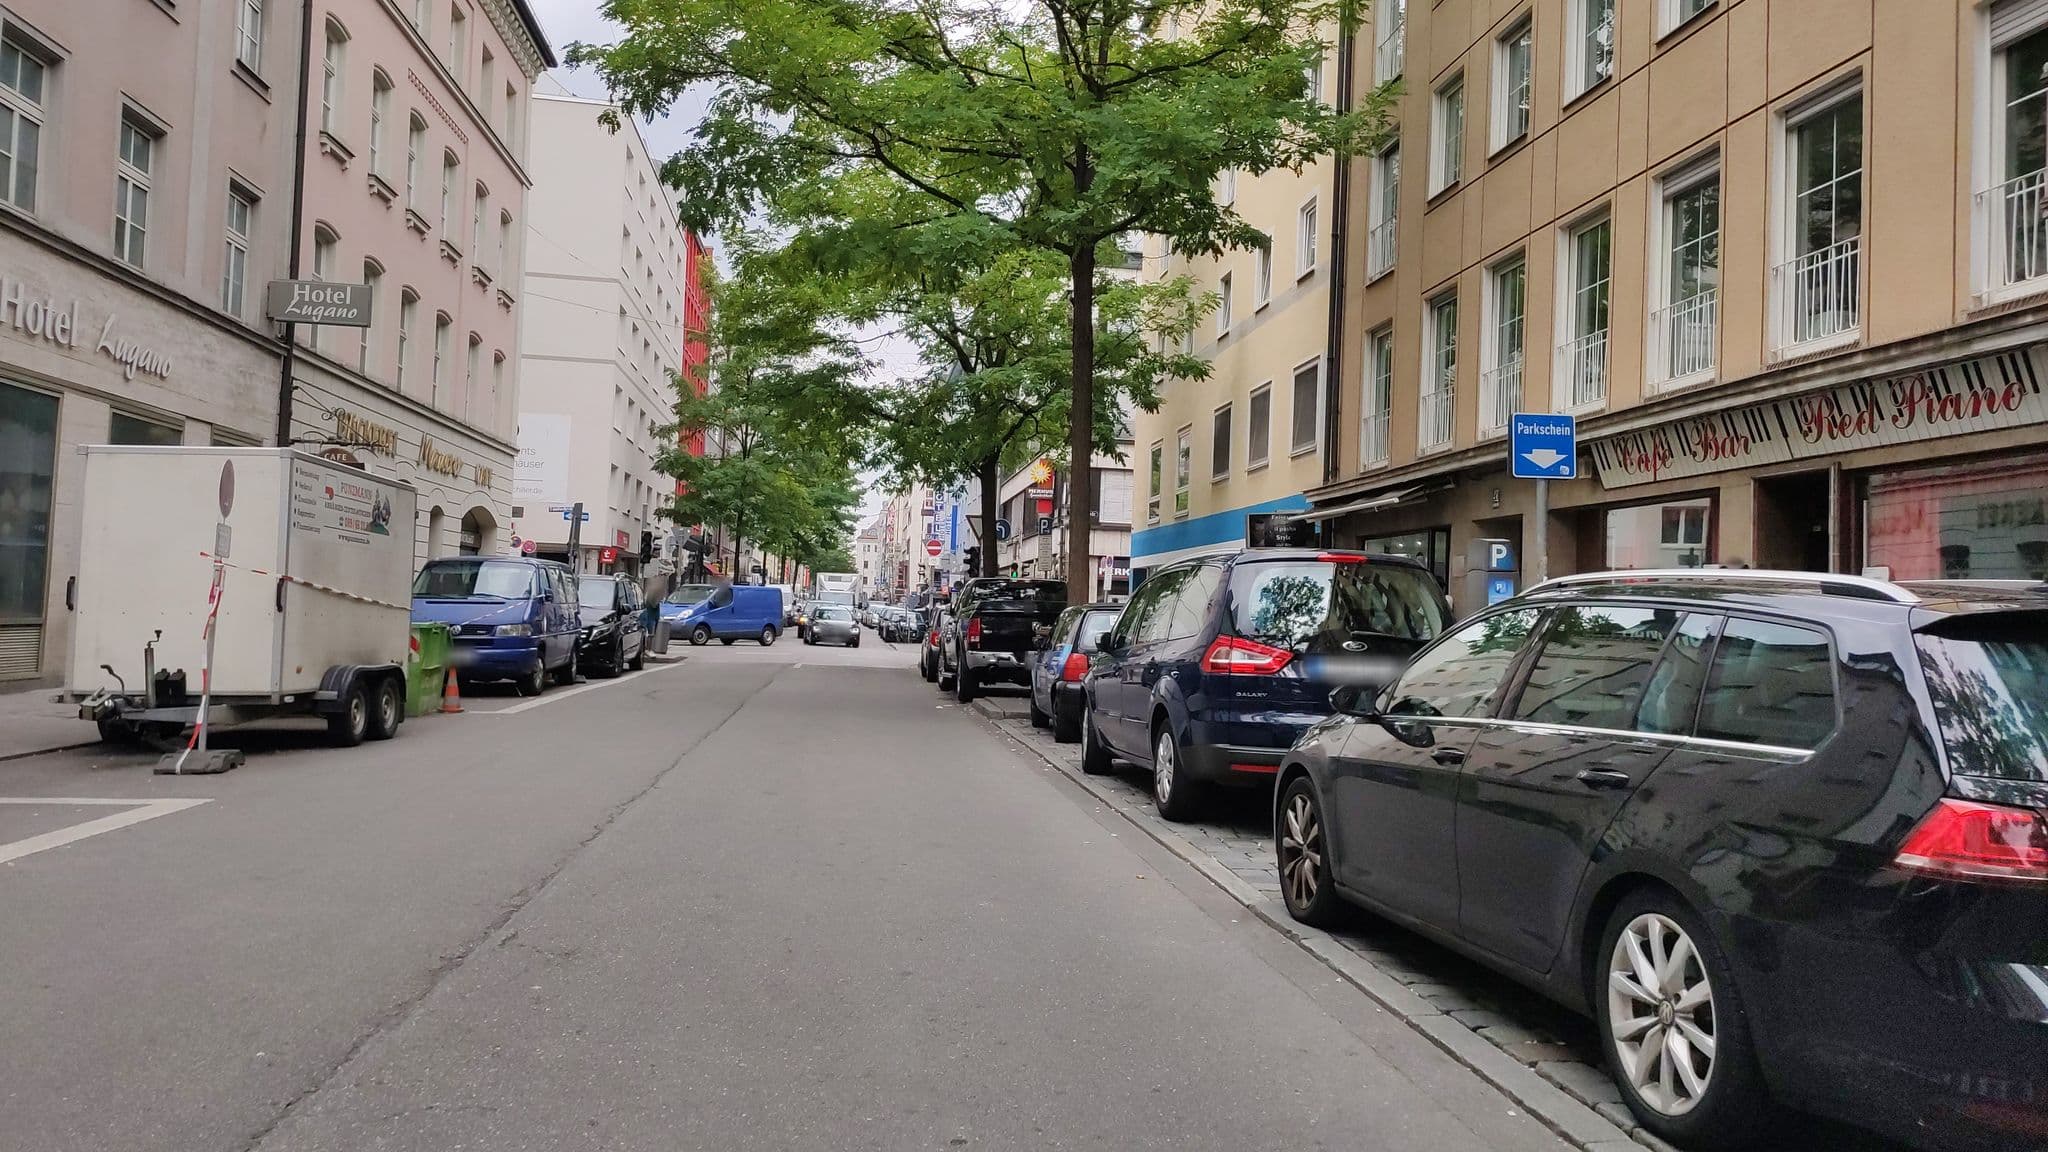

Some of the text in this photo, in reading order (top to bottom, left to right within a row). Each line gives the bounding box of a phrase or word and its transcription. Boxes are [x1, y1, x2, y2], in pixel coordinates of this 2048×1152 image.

[294, 284, 351, 304] Hotel
[285, 297, 357, 322] Lugano
[0, 275, 173, 381] Hotel Lugano
[1518, 422, 1570, 436] Parkschein
[1690, 421, 1751, 462] Bar
[1800, 379, 1880, 444] Red
[1889, 373, 2028, 430] Piano
[324, 453, 347, 461] CAFE
[1492, 544, 1507, 567] P
